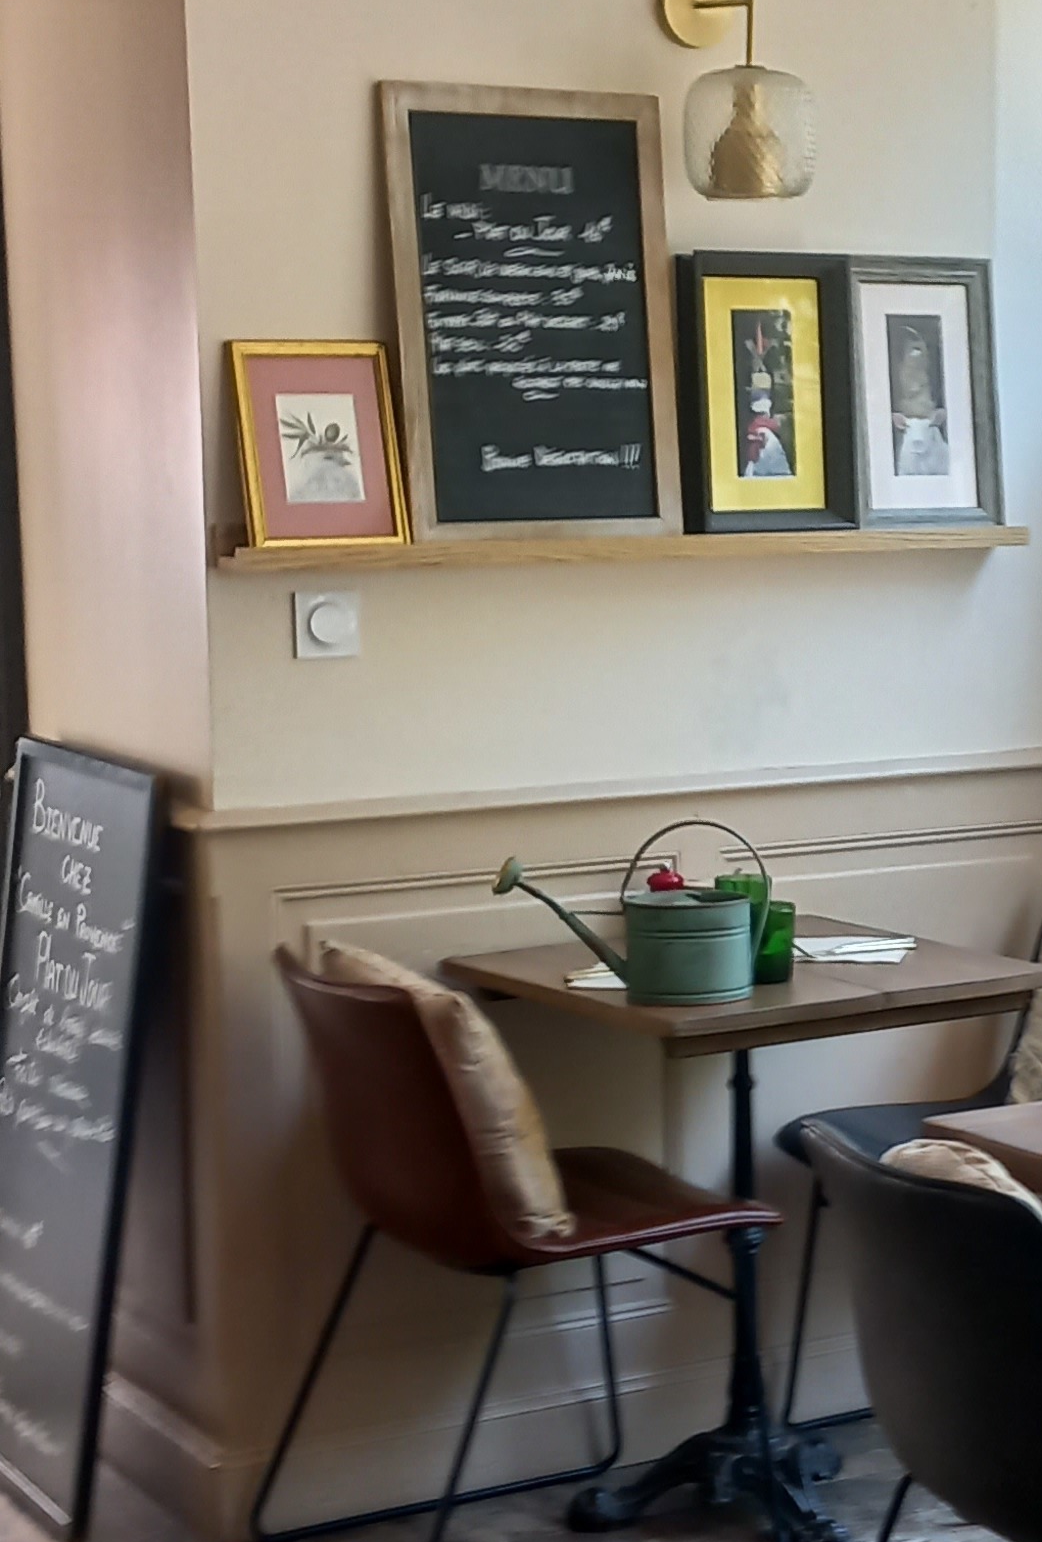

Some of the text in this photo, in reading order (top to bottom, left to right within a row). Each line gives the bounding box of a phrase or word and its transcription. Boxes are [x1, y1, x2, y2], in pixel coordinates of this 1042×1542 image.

[478, 162, 576, 195] MENU
[32, 778, 104, 853] BIENVENUE
[60, 855, 92, 896] CHEZ
